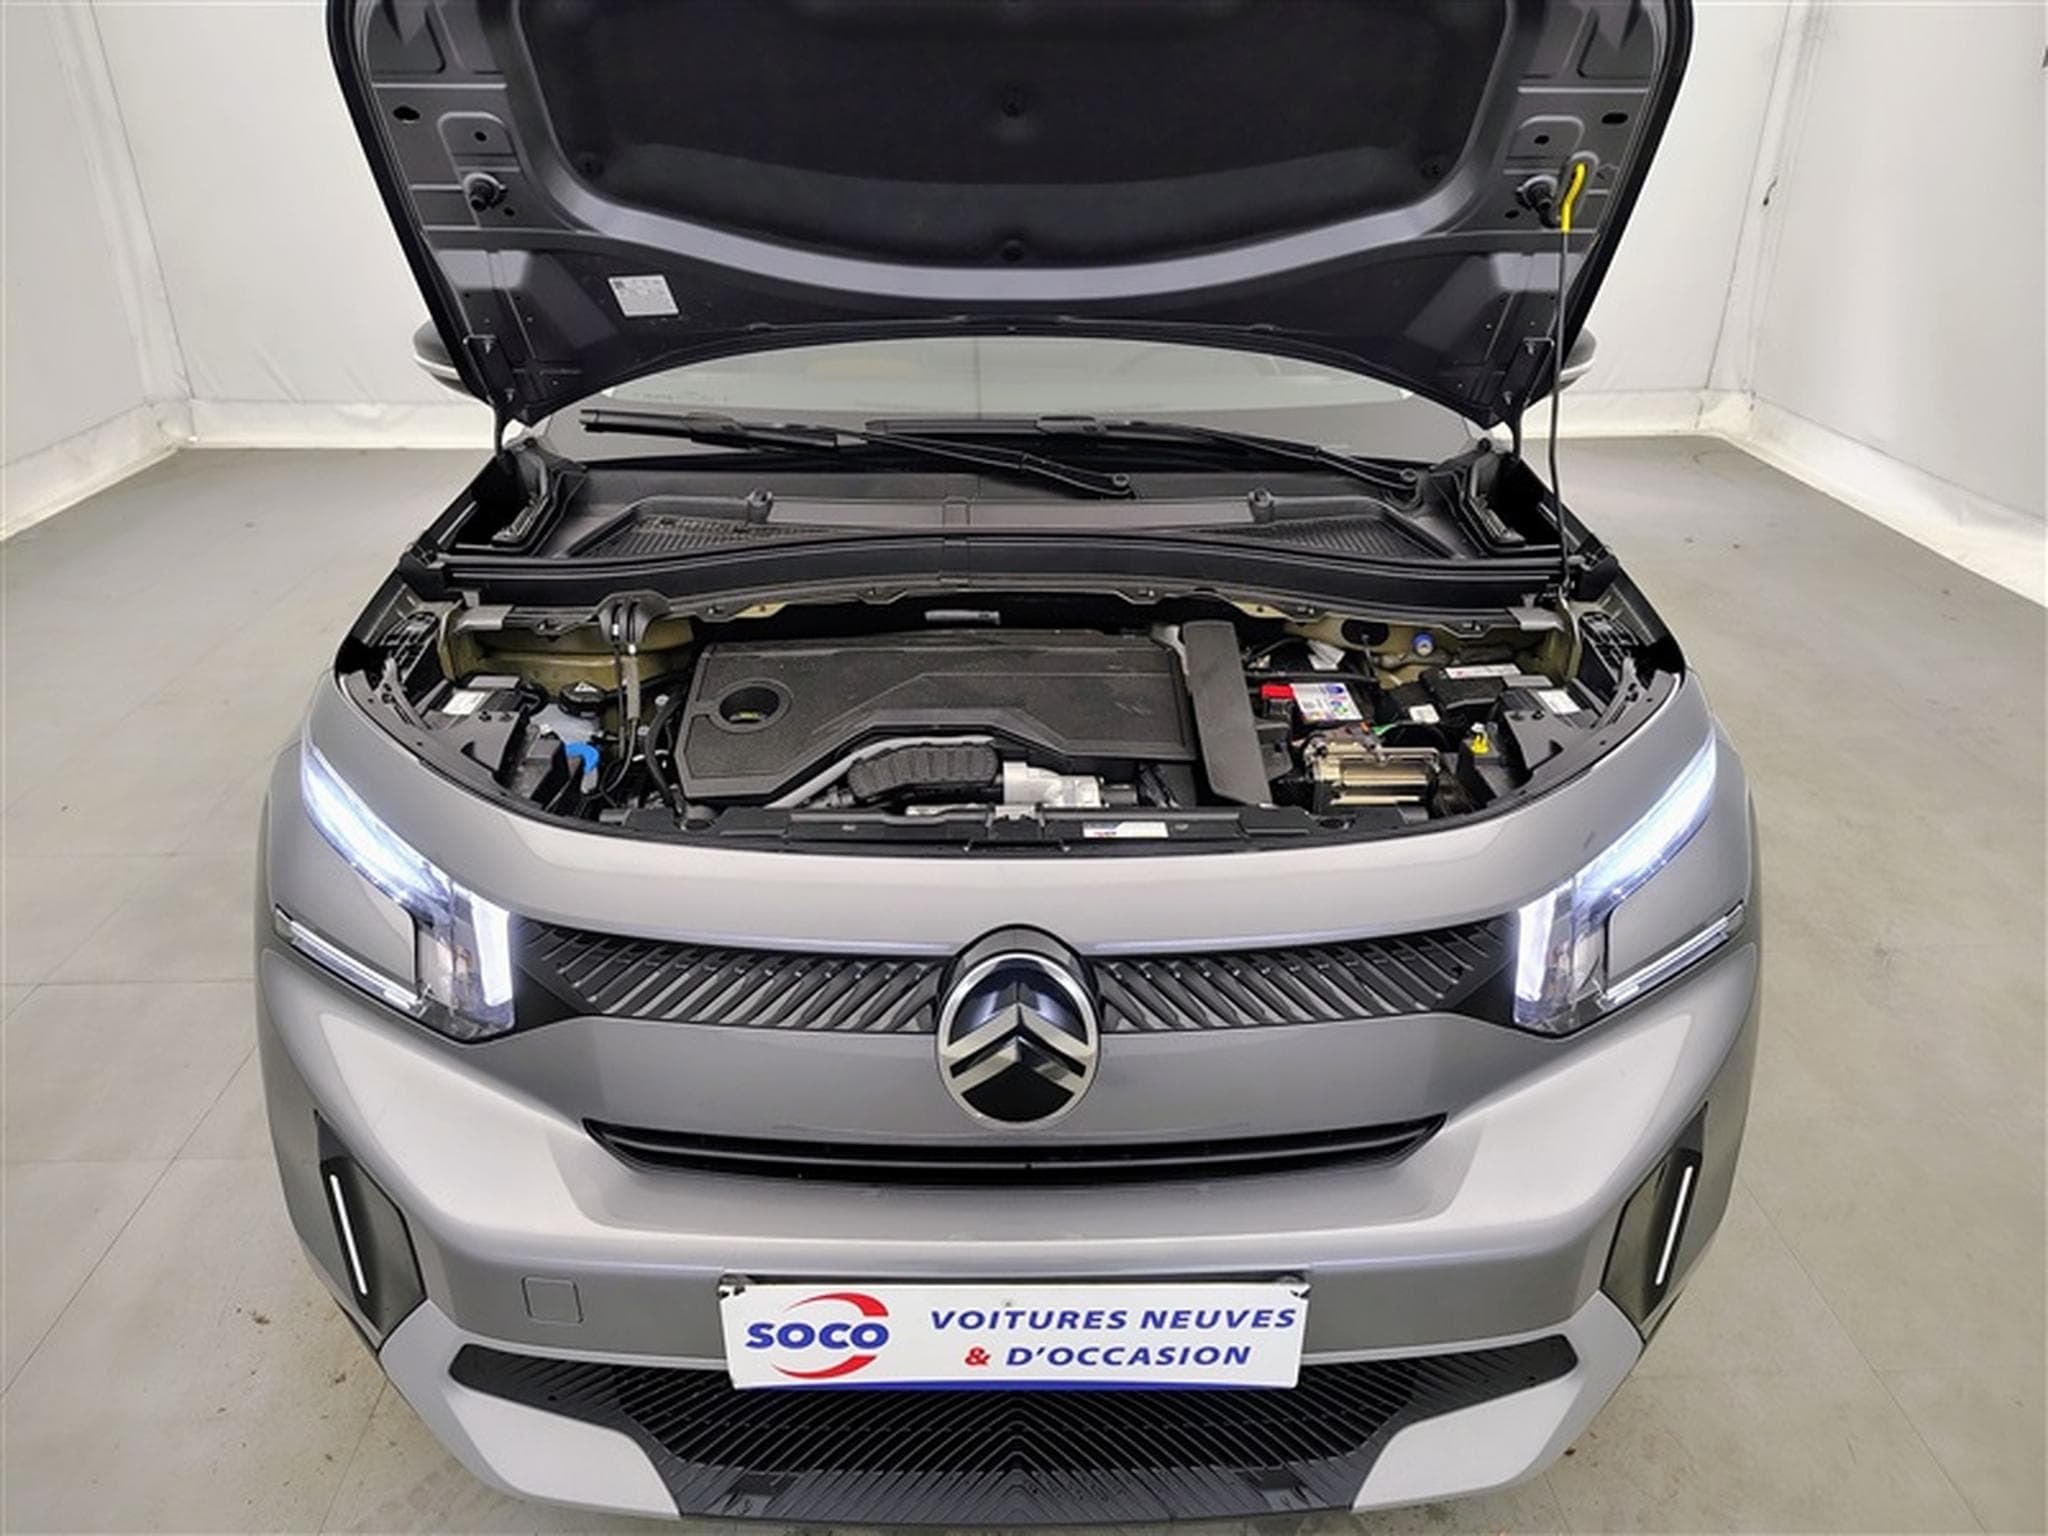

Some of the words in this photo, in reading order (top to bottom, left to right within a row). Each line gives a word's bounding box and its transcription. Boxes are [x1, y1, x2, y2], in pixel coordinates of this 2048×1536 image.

[931, 1309, 1127, 1331] VOITURES
[1140, 1308, 1296, 1330] NEUVES
[745, 1320, 890, 1351] SOCO
[964, 1346, 991, 1367] &
